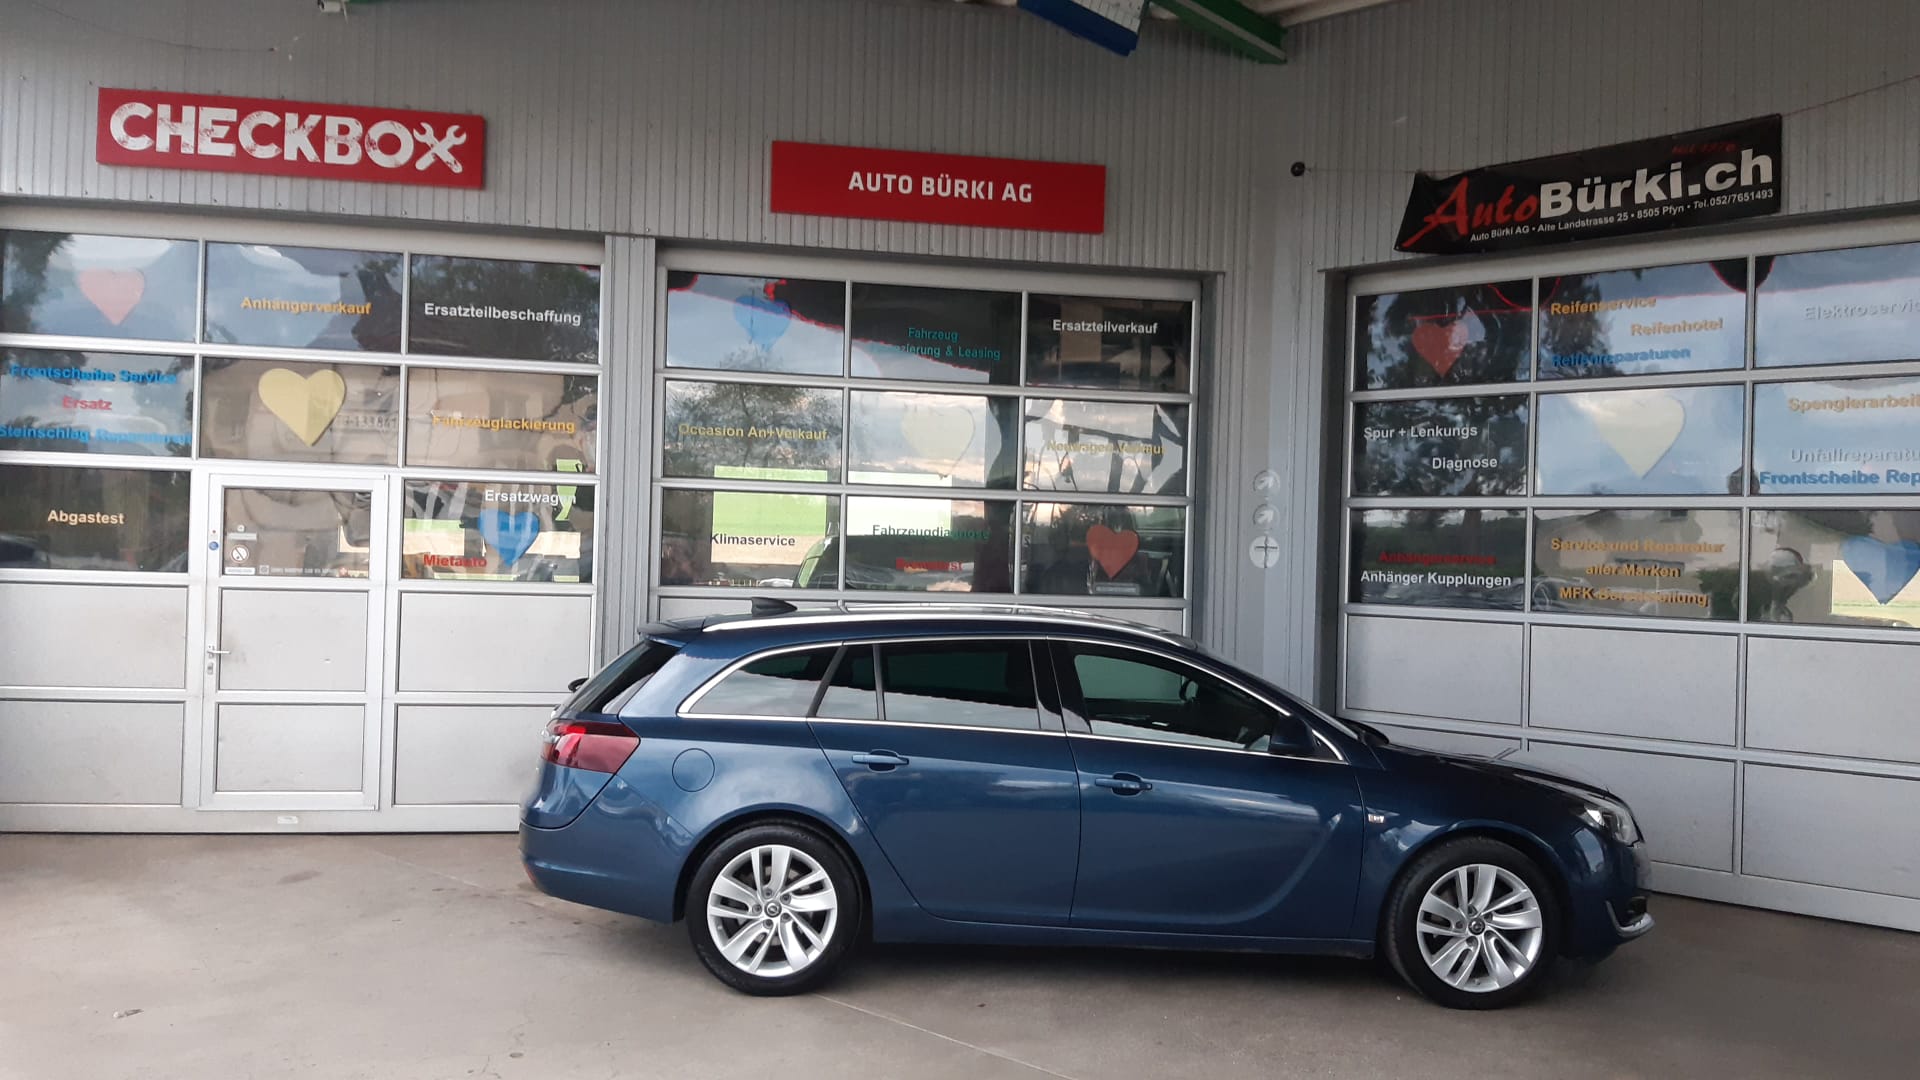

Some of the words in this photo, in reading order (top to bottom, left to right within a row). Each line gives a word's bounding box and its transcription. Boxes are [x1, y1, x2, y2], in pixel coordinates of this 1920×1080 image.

[109, 101, 467, 174] CHECKBOX
[848, 171, 913, 194] AUTO
[921, 173, 994, 201] BÜRKI
[1001, 182, 1032, 203] AG
[1470, 231, 1490, 243] Auto
[1515, 226, 1530, 235] AG
[1537, 223, 1556, 233] Alte
[1558, 214, 1615, 231] Landstrasse
[1617, 212, 1630, 222] 25
[1636, 207, 1661, 220] 8505
[1662, 204, 1685, 217] Pfyn
[424, 302, 582, 327] Ersatzteilbeschaffung
[1550, 297, 1657, 316] Reifenservice
[908, 326, 959, 343] Fahrzeug
[1052, 318, 1159, 336] Ersatzteilverkauf
[1631, 318, 1723, 337] Reifenhotel
[945, 345, 953, 357] &
[958, 345, 1001, 361] Leasing
[61, 394, 113, 411] Ersatz
[678, 423, 744, 438] Occasion
[1364, 427, 1395, 440] Spur
[1399, 428, 1406, 436] +
[1410, 425, 1478, 440] Lenkungs
[1432, 457, 1498, 472] Diagnose
[1760, 470, 1880, 485] Frontscheibe
[47, 509, 125, 525] Abgastest
[711, 532, 796, 547] Klimaservice
[423, 553, 487, 568] Mietauto
[1586, 563, 1617, 575] aller
[1623, 564, 1681, 577] Marken
[1361, 571, 1424, 585] Anhänger
[1427, 572, 1512, 589] Kupplungen
